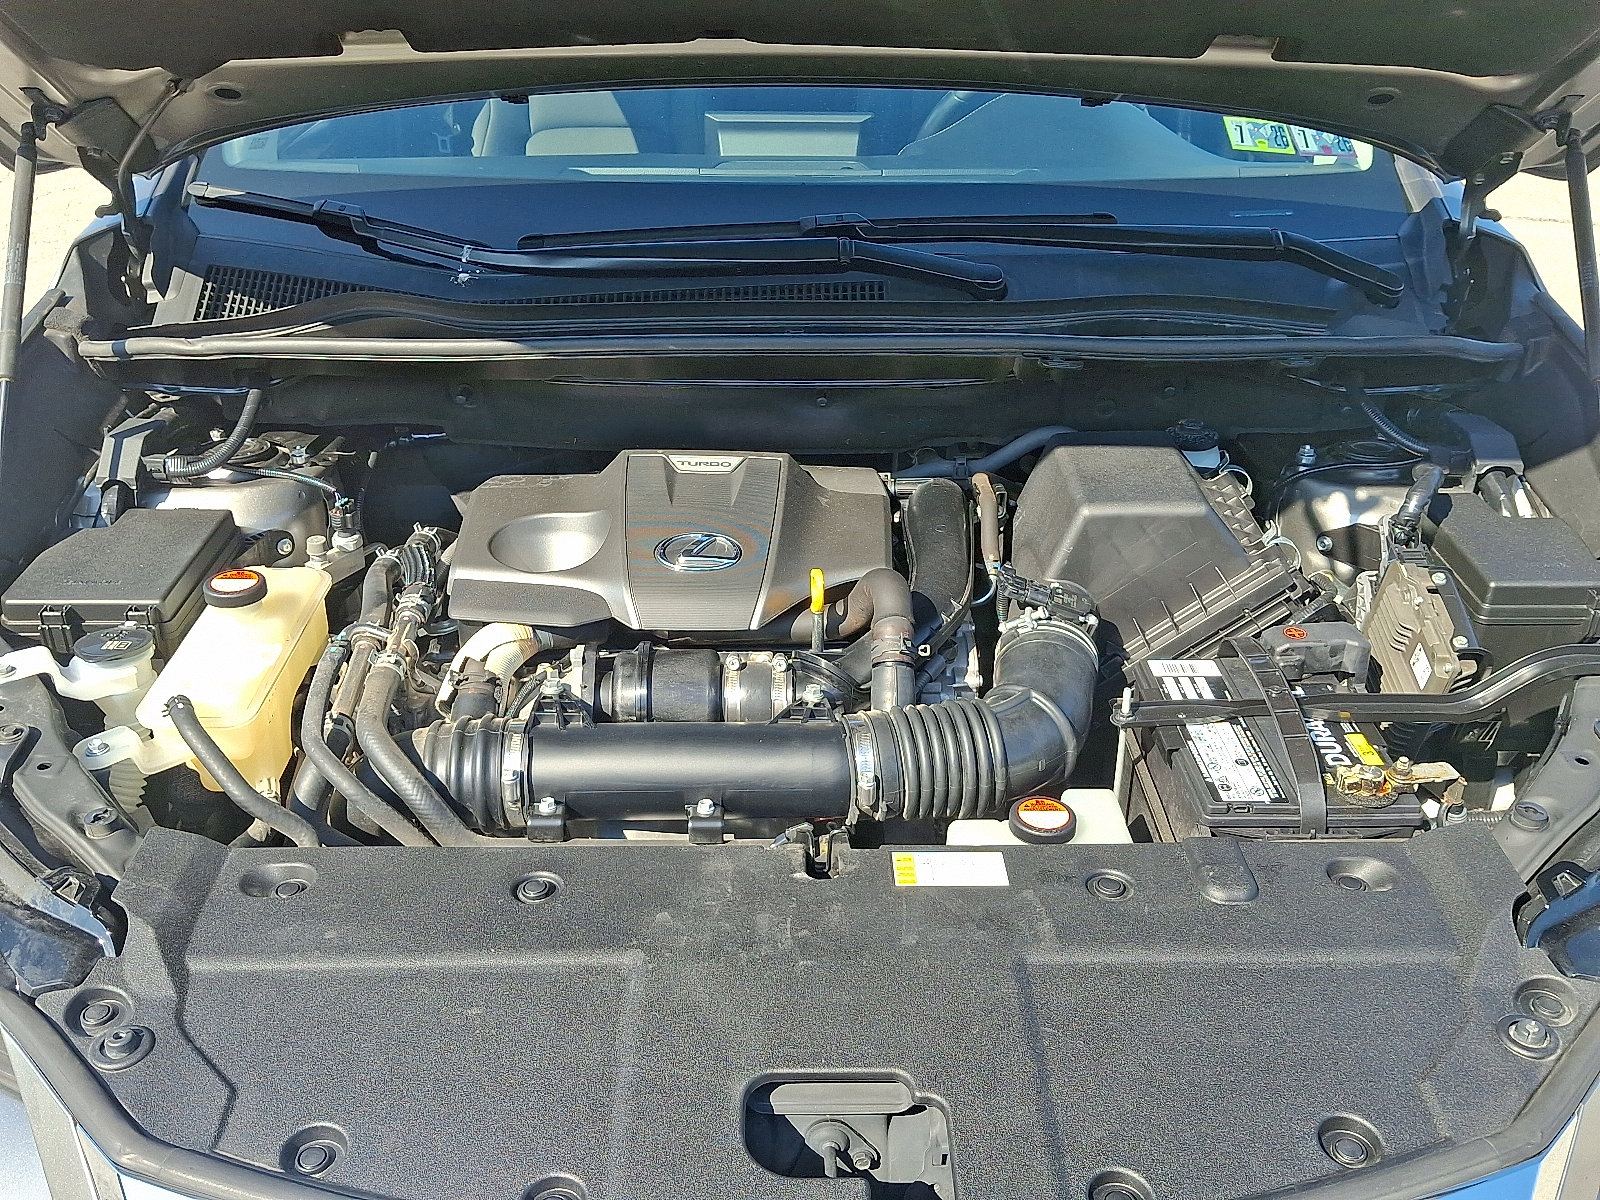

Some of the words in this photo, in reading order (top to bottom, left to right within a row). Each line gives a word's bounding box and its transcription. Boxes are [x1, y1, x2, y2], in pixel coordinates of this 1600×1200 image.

[1234, 124, 1245, 144] 7
[1270, 125, 1289, 147] 26
[1297, 129, 1310, 149] 7
[676, 460, 732, 468] TURBO
